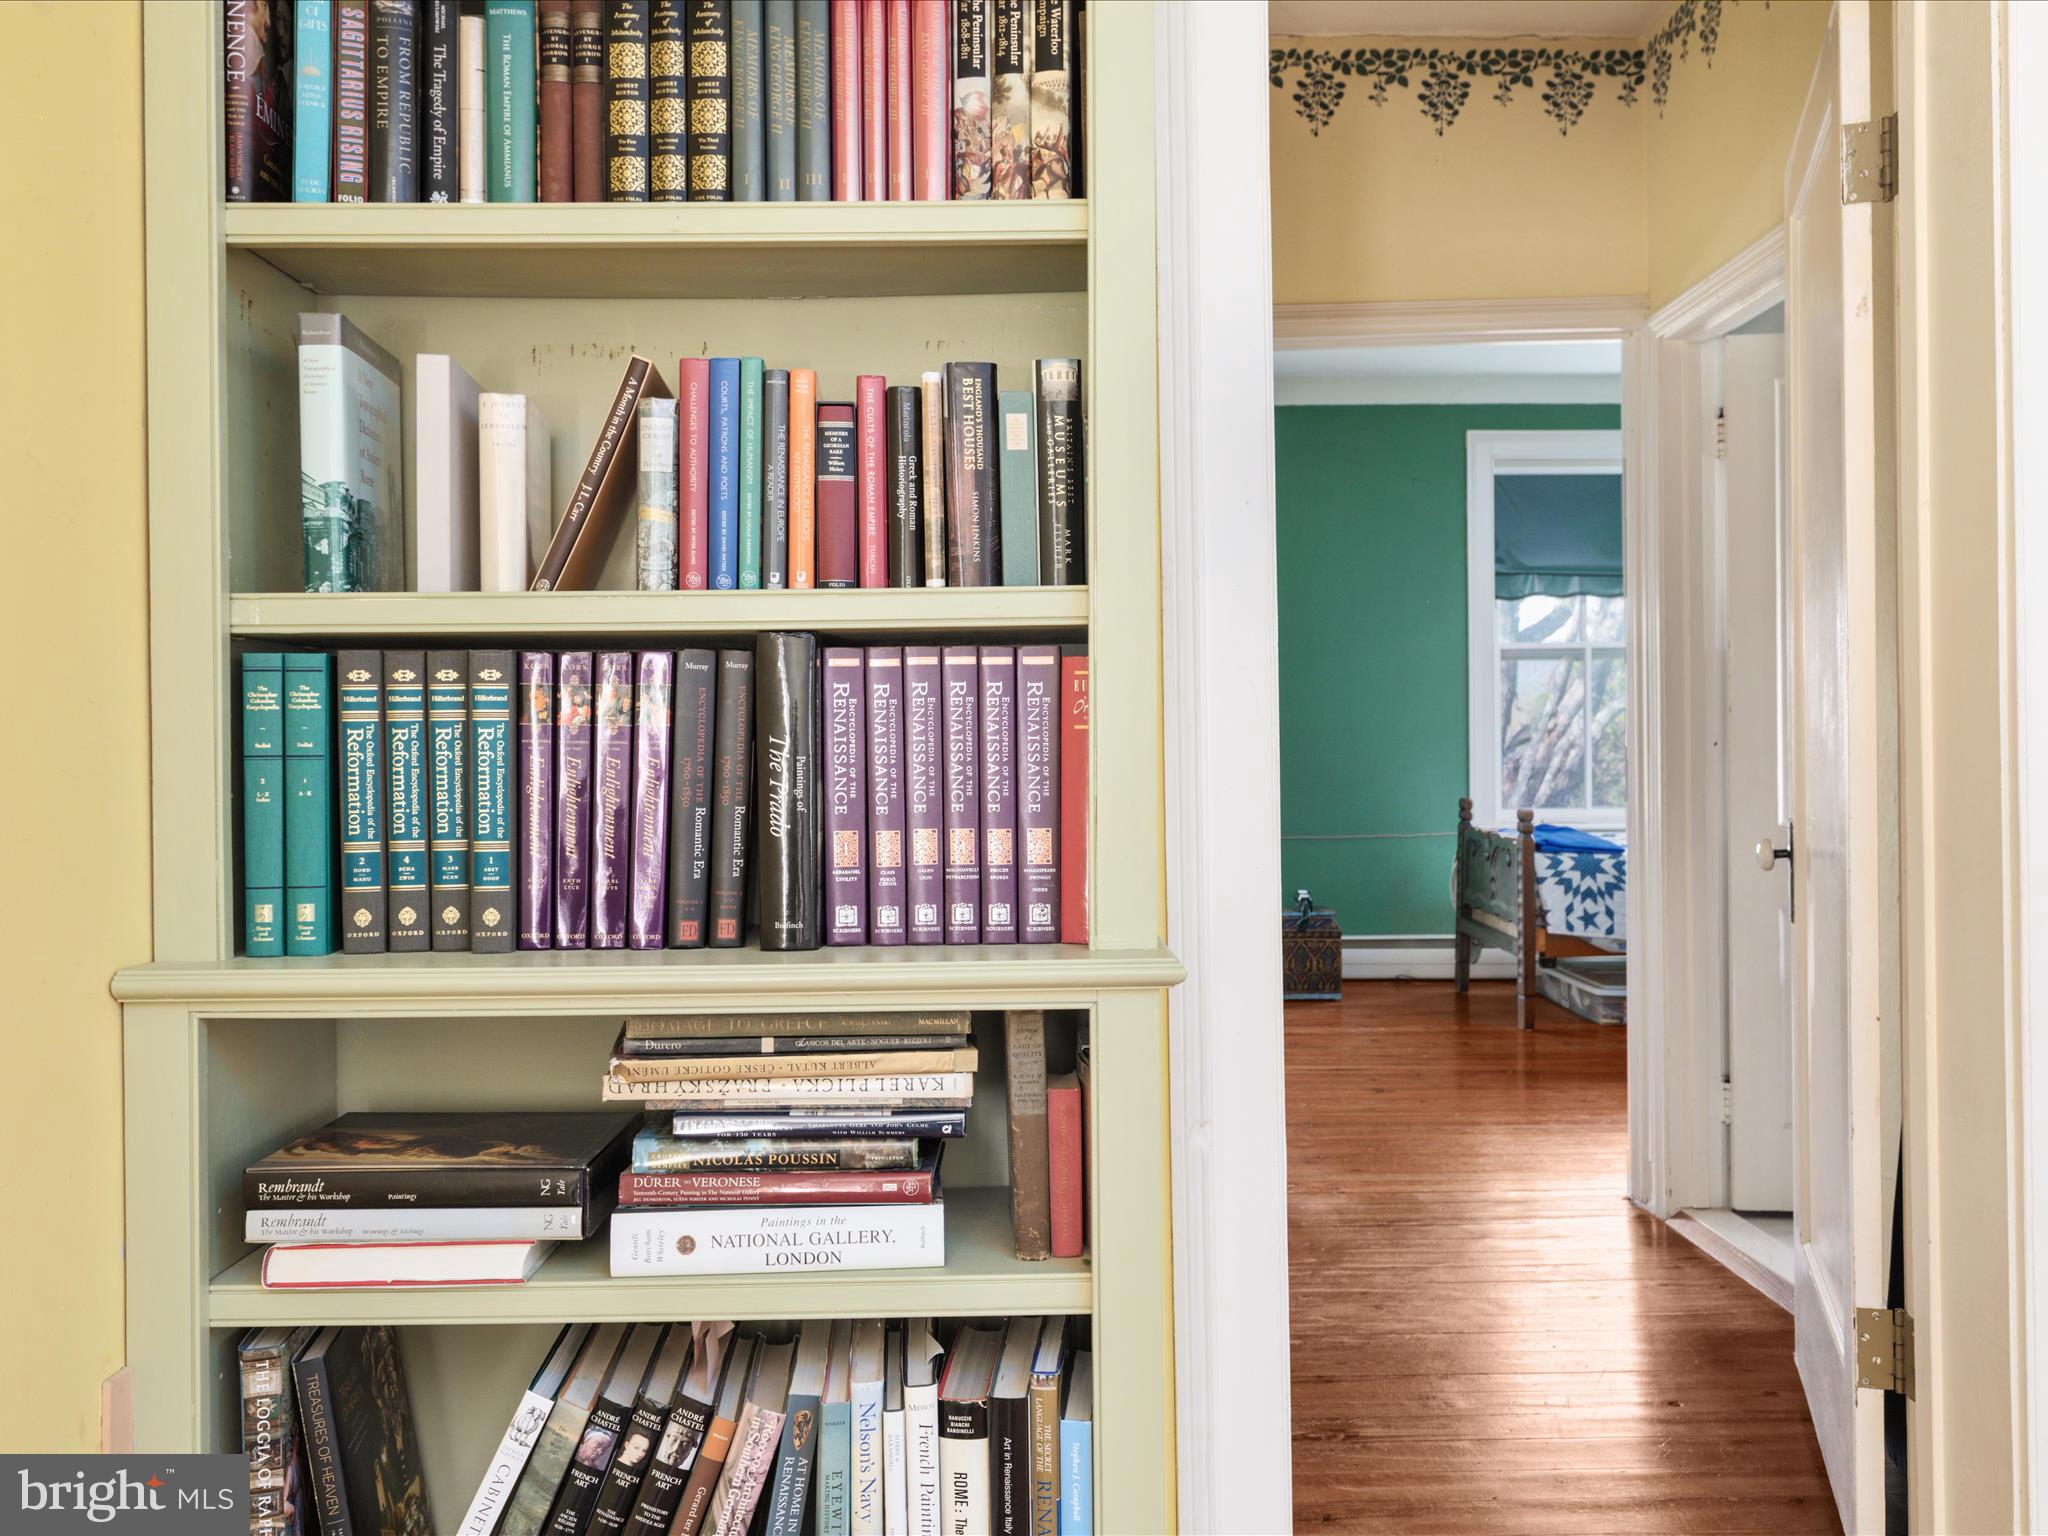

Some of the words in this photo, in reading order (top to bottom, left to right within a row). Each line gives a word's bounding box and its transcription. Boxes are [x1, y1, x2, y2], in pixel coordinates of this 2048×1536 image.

[376, 35, 389, 59] TO
[502, 33, 511, 50] THE
[961, 19, 970, 60] 1808-1811
[972, 13, 983, 69] Peninsular
[997, 16, 1008, 57] 1812-1814
[1010, 8, 1021, 66] Peninsular
[1050, 8, 1062, 55] Waterloo
[340, 7, 365, 120] SAGITTARIUS
[399, 37, 411, 86] FROM
[433, 44, 447, 69] The
[503, 52, 511, 88] ROMAN
[747, 29, 758, 98] MEMOIRS
[376, 65, 389, 129] EMPIRE
[429, 70, 447, 116] Tragedy
[503, 90, 511, 123] EMPIRE
[433, 118, 447, 134] of
[747, 101, 759, 120] OF
[399, 91, 411, 174] REPUBLIC
[503, 125, 512, 136] OF
[340, 125, 364, 183] RISING
[429, 136, 446, 180] Empire
[504, 140, 512, 188] AMMIANUS
[628, 377, 637, 386] A
[720, 380, 728, 415] COURTS,
[962, 378, 974, 410] BEST
[615, 387, 635, 417] Month
[975, 378, 983, 424] ENGLAND'S
[605, 422, 617, 438] the
[612, 415, 622, 423] in
[778, 425, 786, 439] THE
[903, 402, 911, 442] Marincola
[690, 437, 697, 445] TO
[720, 417, 728, 454] PATRONS
[868, 437, 875, 447] OF
[963, 415, 975, 470] HOUSES
[588, 439, 611, 475] Country
[720, 457, 728, 473] AND
[778, 441, 786, 498] RENAISSANCE
[909, 455, 917, 480] Greek
[1053, 415, 1067, 507] MUSEUMS
[720, 476, 728, 500] POETS
[867, 468, 875, 498] ROMAN
[896, 455, 906, 520] Historiography
[569, 502, 585, 522] Carr
[778, 501, 785, 509] IN
[868, 503, 876, 536] EMPIRE
[909, 499, 917, 531] Roman
[777, 510, 785, 543] EUROPE
[1064, 529, 1072, 564] MARK
[685, 661, 709, 671] Murray
[725, 661, 749, 671] Murray
[698, 687, 706, 761] ENCYCLOPEDIA
[849, 698, 857, 764] ENCYCLOPEDIA
[768, 734, 790, 777] The
[833, 682, 850, 816] RENAISSANCE
[873, 683, 890, 817] RENAISSANCE
[911, 681, 928, 815] RENAISSANCE
[950, 680, 966, 814] RENAISSANCE
[347, 728, 364, 837] Reformation
[391, 727, 409, 835] Reformation
[435, 727, 453, 835] Reformation
[477, 727, 495, 835] Reformation
[681, 757, 692, 808] 1760-1850
[698, 763, 705, 776] OF
[793, 756, 806, 798] Paintings
[849, 767, 856, 777] OF
[525, 754, 545, 857] Enlightenment
[565, 755, 583, 859] Enlightenment
[603, 757, 620, 860] Enlightenment
[769, 779, 791, 838] Prado
[797, 800, 806, 812] of
[694, 807, 706, 854] Romantic
[693, 857, 704, 879] Era
[918, 1017, 959, 1025] MACMILLAN
[645, 1040, 682, 1050] Durero
[609, 1081, 667, 1094] HRAD
[675, 1079, 772, 1097] PRAŽSKÝ
[793, 1079, 868, 1094] PLICKA
[879, 1077, 944, 1092] KAREL
[693, 1155, 763, 1166] NICOLAS
[768, 1153, 838, 1165] POUSSIN
[258, 1178, 325, 1194] Rembrandt
[259, 1193, 271, 1201] The
[272, 1193, 297, 1201] Master
[297, 1192, 306, 1202] &
[308, 1193, 318, 1201] his
[319, 1193, 351, 1202] Workshop
[388, 1193, 418, 1202] Paintings
[540, 1177, 551, 1197] NG
[633, 1176, 681, 1188] DÜRER
[693, 1177, 761, 1187] VERONESE
[260, 1214, 327, 1228] Rembrandt
[761, 1217, 812, 1228] Paintings
[815, 1217, 826, 1225] in
[830, 1216, 846, 1225] the
[711, 1232, 803, 1248] NATIONAL
[765, 1251, 842, 1266] LONDON
[256, 1359, 269, 1393] THE
[307, 1373, 328, 1445] TREASURES
[590, 1416, 621, 1432] CHASTEL
[596, 1410, 620, 1424] ANDRÉ
[632, 1414, 662, 1432] CHASTEL
[257, 1397, 270, 1464] LOGGIA
[860, 1402, 876, 1473] Nelson's
[1004, 1437, 1012, 1451] Art
[318, 1446, 330, 1463] OF
[919, 1424, 935, 1474] French
[1036, 1442, 1043, 1454] OF
[1072, 1441, 1081, 1471] Stephen
[257, 1469, 271, 1490] OF
[322, 1466, 340, 1516] HEAVEN
[571, 1468, 599, 1484] FRENCH
[574, 1477, 590, 1489] ART
[612, 1468, 640, 1484] FRENCH
[1004, 1462, 1012, 1514] Renaissance
[860, 1479, 877, 1523] Navy
[954, 1473, 968, 1512] ROME:
[1071, 1482, 1082, 1521] Campbell
[640, 1502, 669, 1517] PREHISTORY
[1004, 1516, 1012, 1534] Italy
[955, 1518, 968, 1536] The
